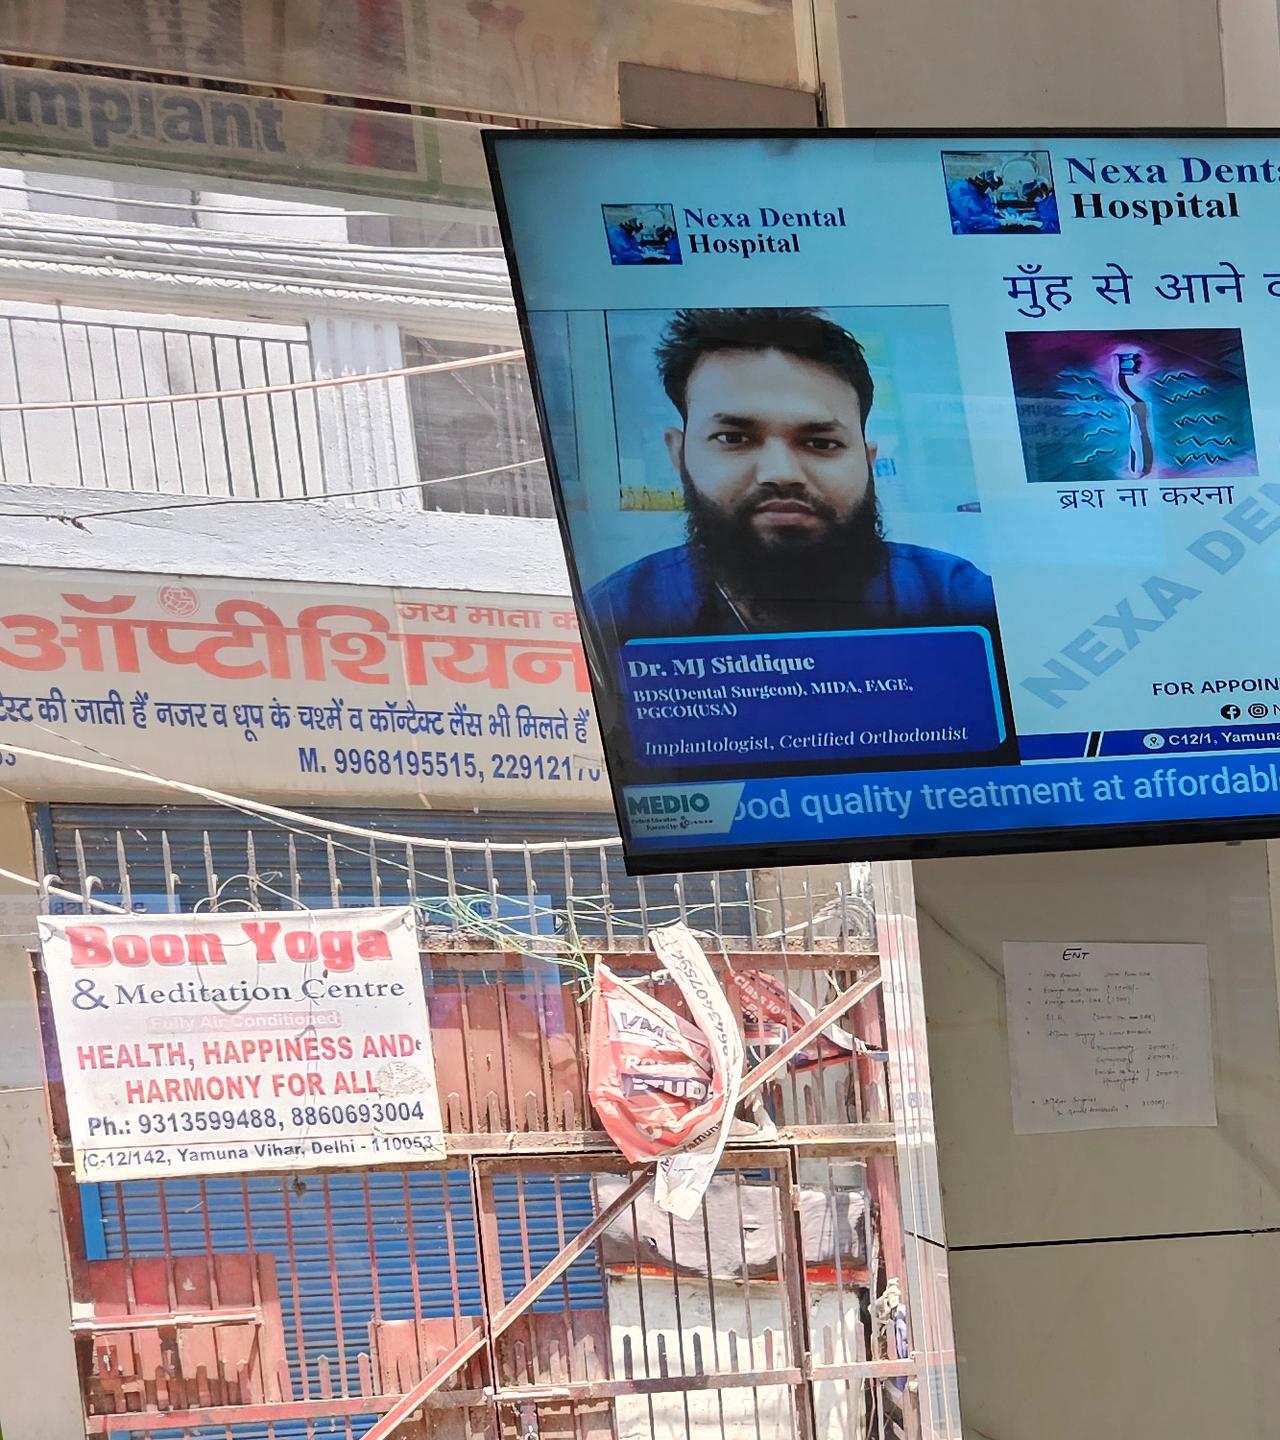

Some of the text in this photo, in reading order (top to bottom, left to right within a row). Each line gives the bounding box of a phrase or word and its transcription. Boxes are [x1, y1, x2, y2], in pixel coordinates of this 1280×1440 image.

[1065, 158, 1169, 185] Nexa
[1073, 192, 1239, 227] Hospital
[1003, 264, 1073, 318] मुँह
[1093, 263, 1132, 304] से
[1155, 261, 1246, 304] आने
[1057, 485, 1235, 512] ब्रश ना करना
[399, 602, 543, 629] जय माता
[0, 593, 592, 693] ऑप्टीशियन
[628, 654, 816, 679] Dr. MJ Siddique
[634, 678, 913, 703] BDS(Dental Surgeon), MIDA, FAGE,
[1152, 681, 1195, 697] FOR
[36, 687, 68, 723] की
[71, 689, 126, 725] जाती
[129, 690, 150, 729] हैं
[154, 702, 207, 728] नजर
[211, 704, 228, 728] व
[233, 704, 265, 742] धूप
[348, 708, 363, 732] व
[489, 704, 511, 738] भी
[516, 705, 569, 740] मिलते
[573, 708, 591, 744] हैं
[636, 701, 737, 721] PGCOI(USA)
[645, 724, 969, 758] Implantologist, Certified Orthodontist
[1169, 731, 1218, 747] C12/1,
[298, 748, 485, 783] M. 9968195515,
[628, 793, 711, 815] MEDIO
[801, 785, 913, 824] quality
[924, 780, 1082, 810] treatment
[1094, 775, 1126, 801] at
[66, 921, 393, 972] Boon Yoga
[72, 978, 405, 1011] & Meditation Centre
[77, 1034, 416, 1071] HEALTH, HAPPINESS AND
[125, 1069, 380, 1104] HARMONY FOR ALL
[88, 1101, 425, 1137] Ph.: 9313599488, 8860693004
[177, 1145, 249, 1163] Yamuna
[254, 1141, 305, 1159] Vihar,
[311, 1137, 356, 1155] Delhi
